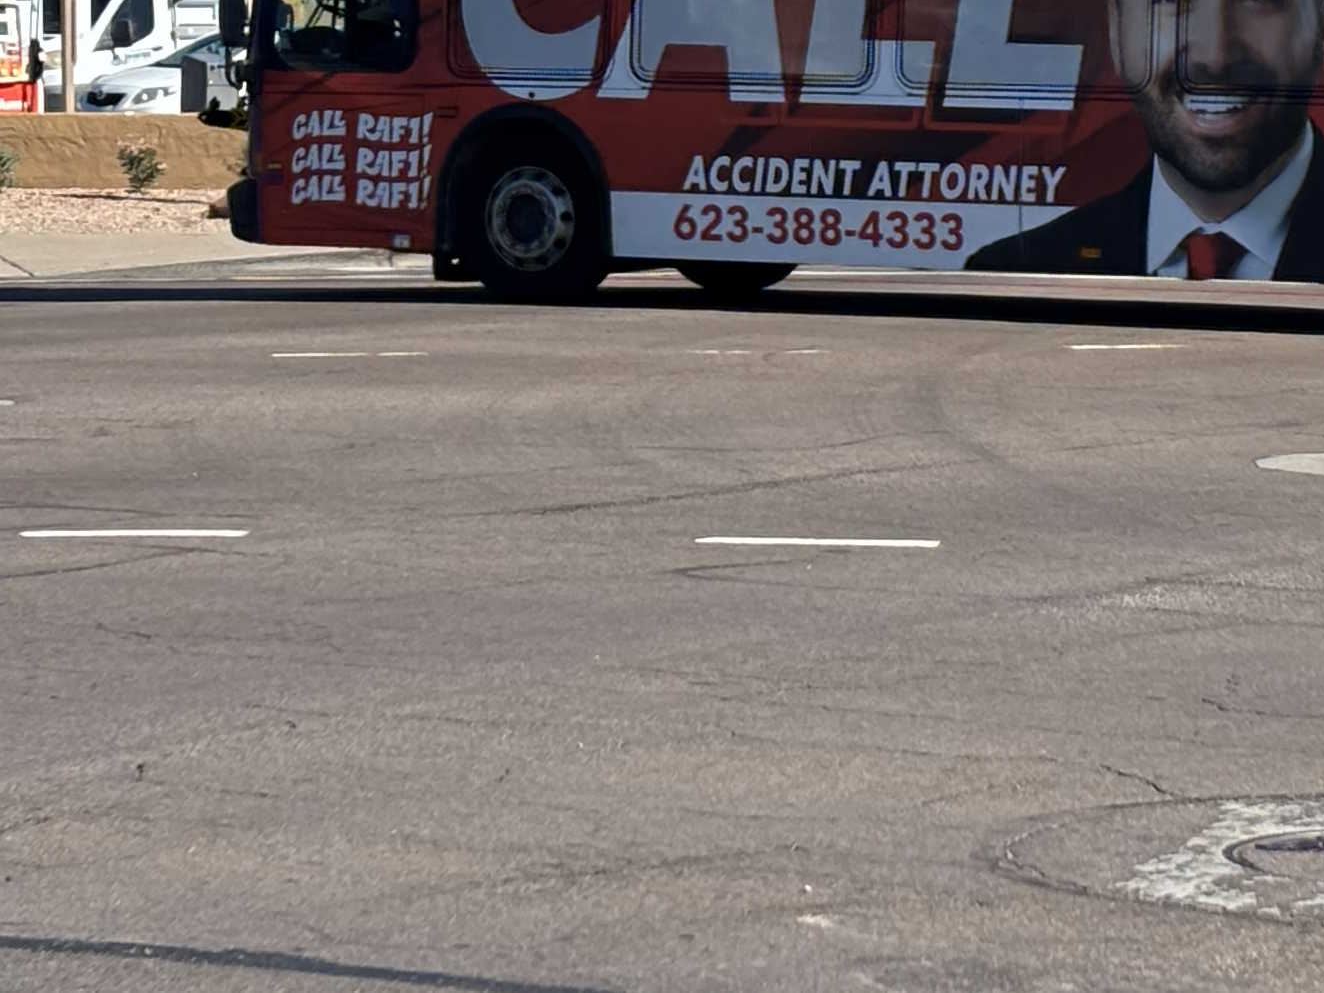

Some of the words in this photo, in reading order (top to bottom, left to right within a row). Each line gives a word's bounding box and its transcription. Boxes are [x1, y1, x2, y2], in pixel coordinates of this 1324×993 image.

[292, 110, 347, 140] CALL
[356, 112, 434, 144] RAFI!
[291, 143, 347, 174] CALL
[356, 144, 433, 178] RAFI!
[291, 174, 347, 205] CALL
[356, 175, 432, 210] RAFI!
[682, 155, 861, 197] ACCIDENT
[867, 160, 1067, 203] ATTORNEY
[673, 204, 964, 252] 623-388-4333
